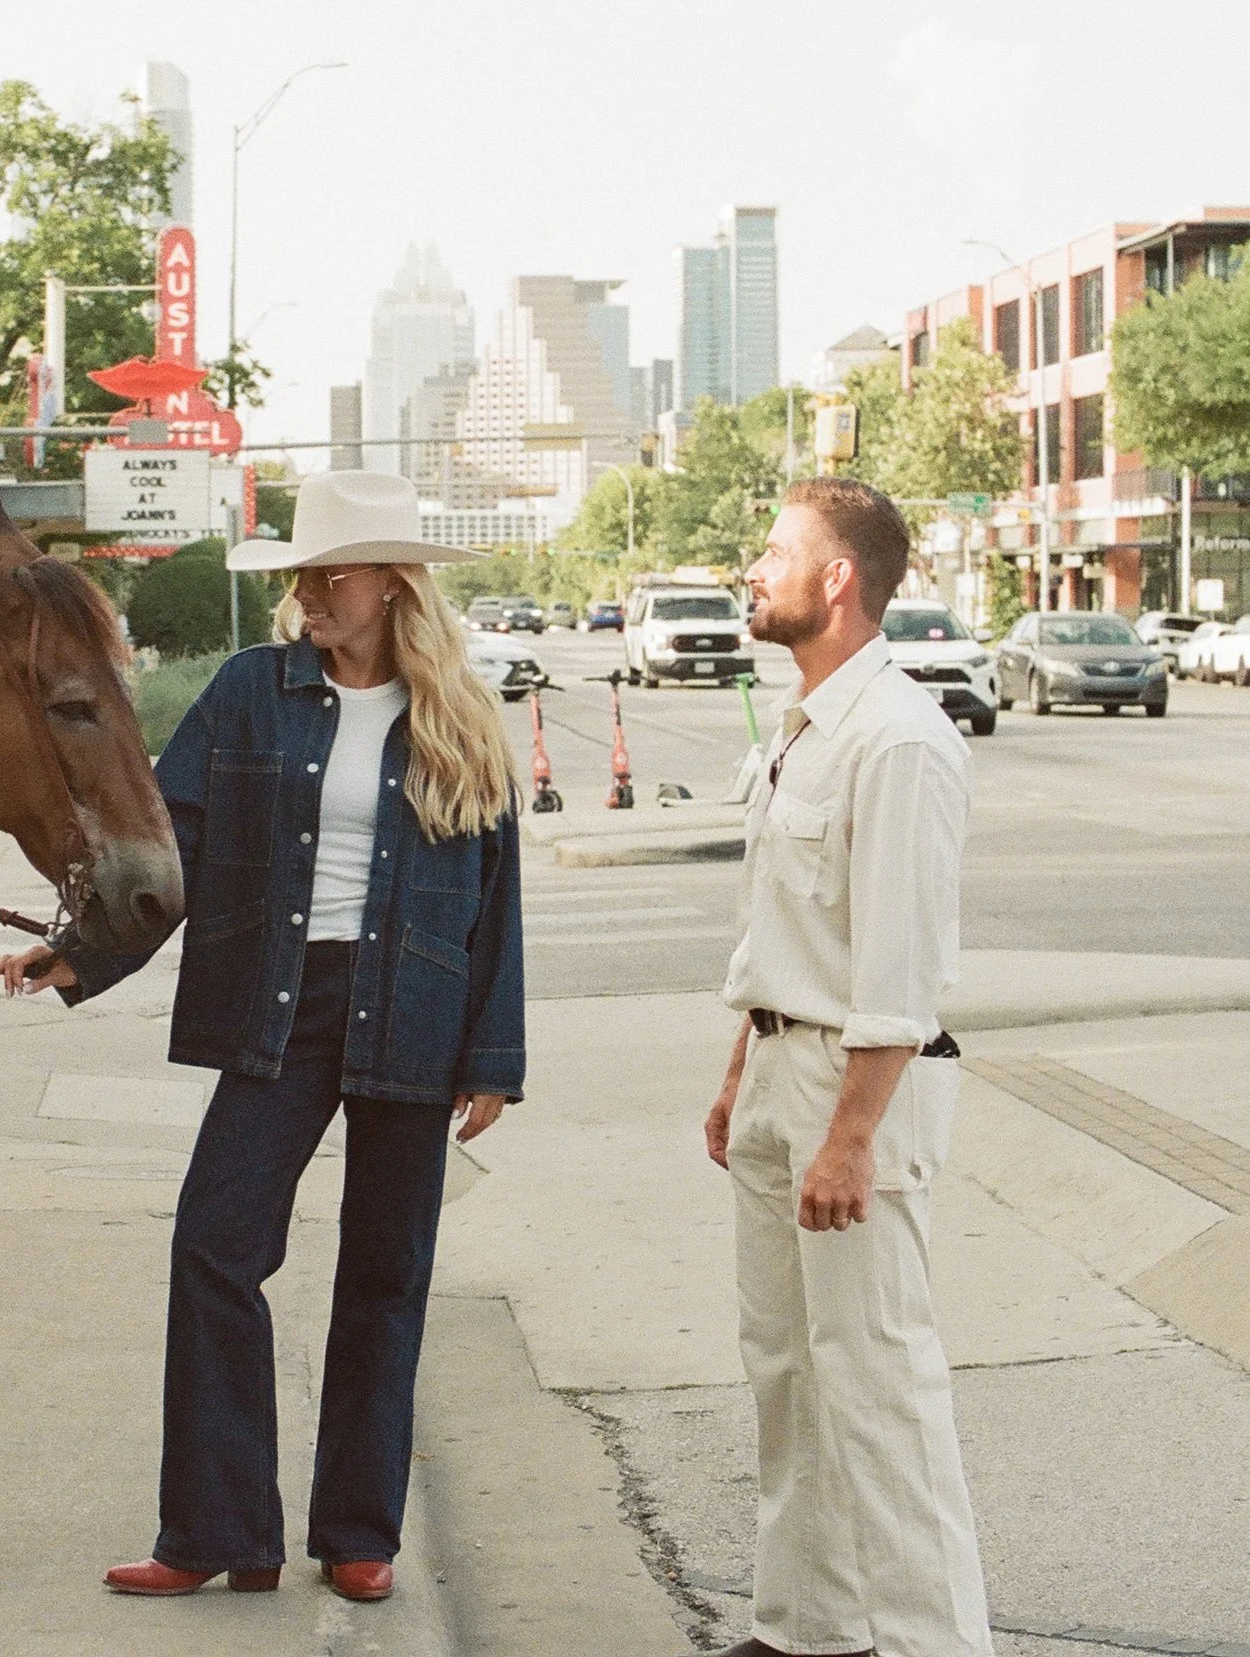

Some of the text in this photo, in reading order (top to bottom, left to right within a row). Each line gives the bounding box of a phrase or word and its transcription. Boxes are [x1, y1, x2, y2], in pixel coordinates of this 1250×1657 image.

[165, 242, 191, 415] AUSTN
[122, 459, 177, 470] ALWAYS
[130, 476, 167, 487] COOL
[138, 492, 156, 504] AT
